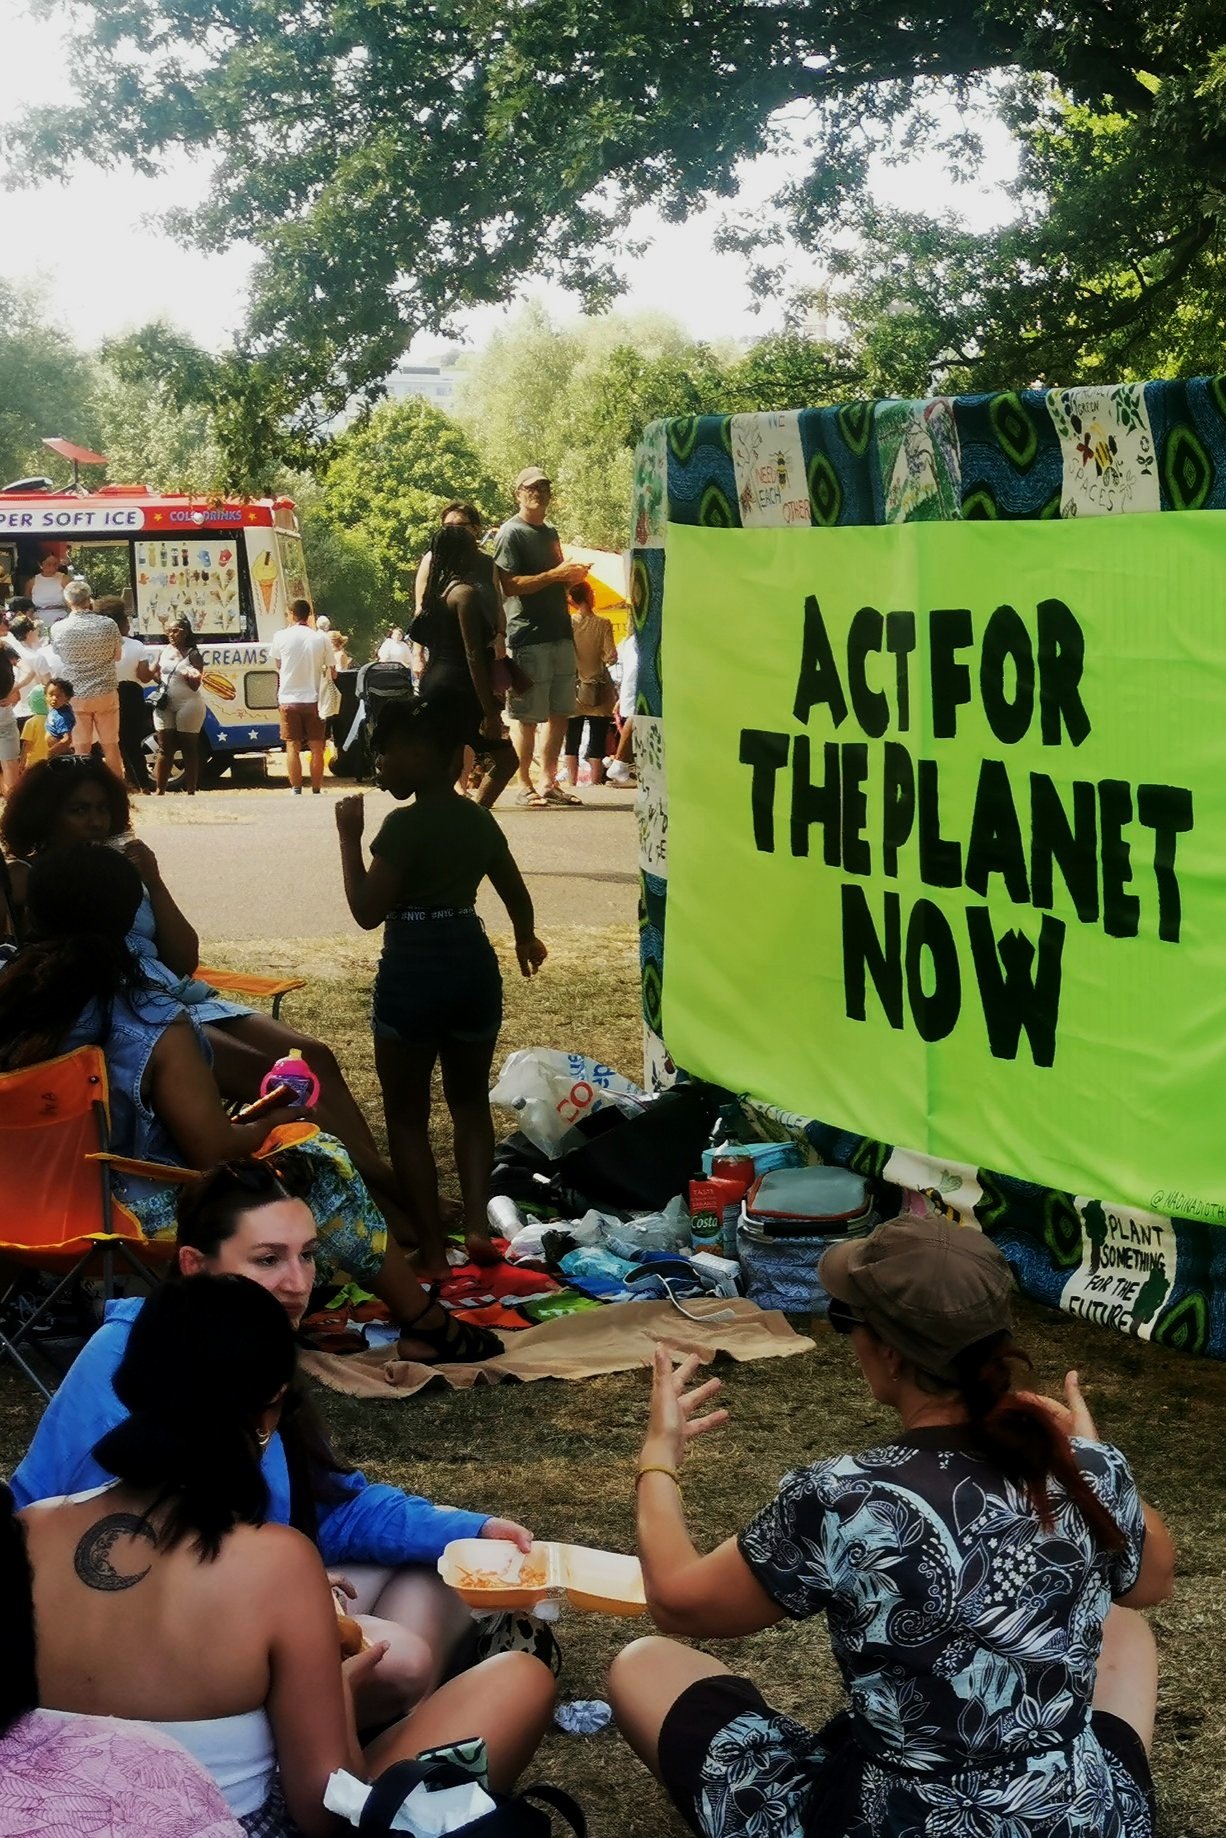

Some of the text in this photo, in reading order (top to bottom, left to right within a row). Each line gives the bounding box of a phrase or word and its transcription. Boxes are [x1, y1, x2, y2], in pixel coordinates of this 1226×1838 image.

[1068, 457, 1116, 511] SPACES
[42, 511, 96, 527] SOFT
[104, 511, 138, 526] ICE
[169, 510, 243, 522] COL DRINKS
[783, 499, 812, 523] OTHER
[202, 648, 269, 666] CREAMS
[793, 594, 1092, 748] ACT FOR
[739, 728, 871, 876] THE
[883, 741, 1194, 943] PLANET
[840, 884, 1066, 1068] NOW
[690, 1215, 719, 1229] Costa
[1108, 1213, 1164, 1247] PLANT
[1100, 1243, 1166, 1272] SOMETHING
[1084, 1275, 1140, 1301] FOR THE
[1069, 1295, 1133, 1332] FUTURE
